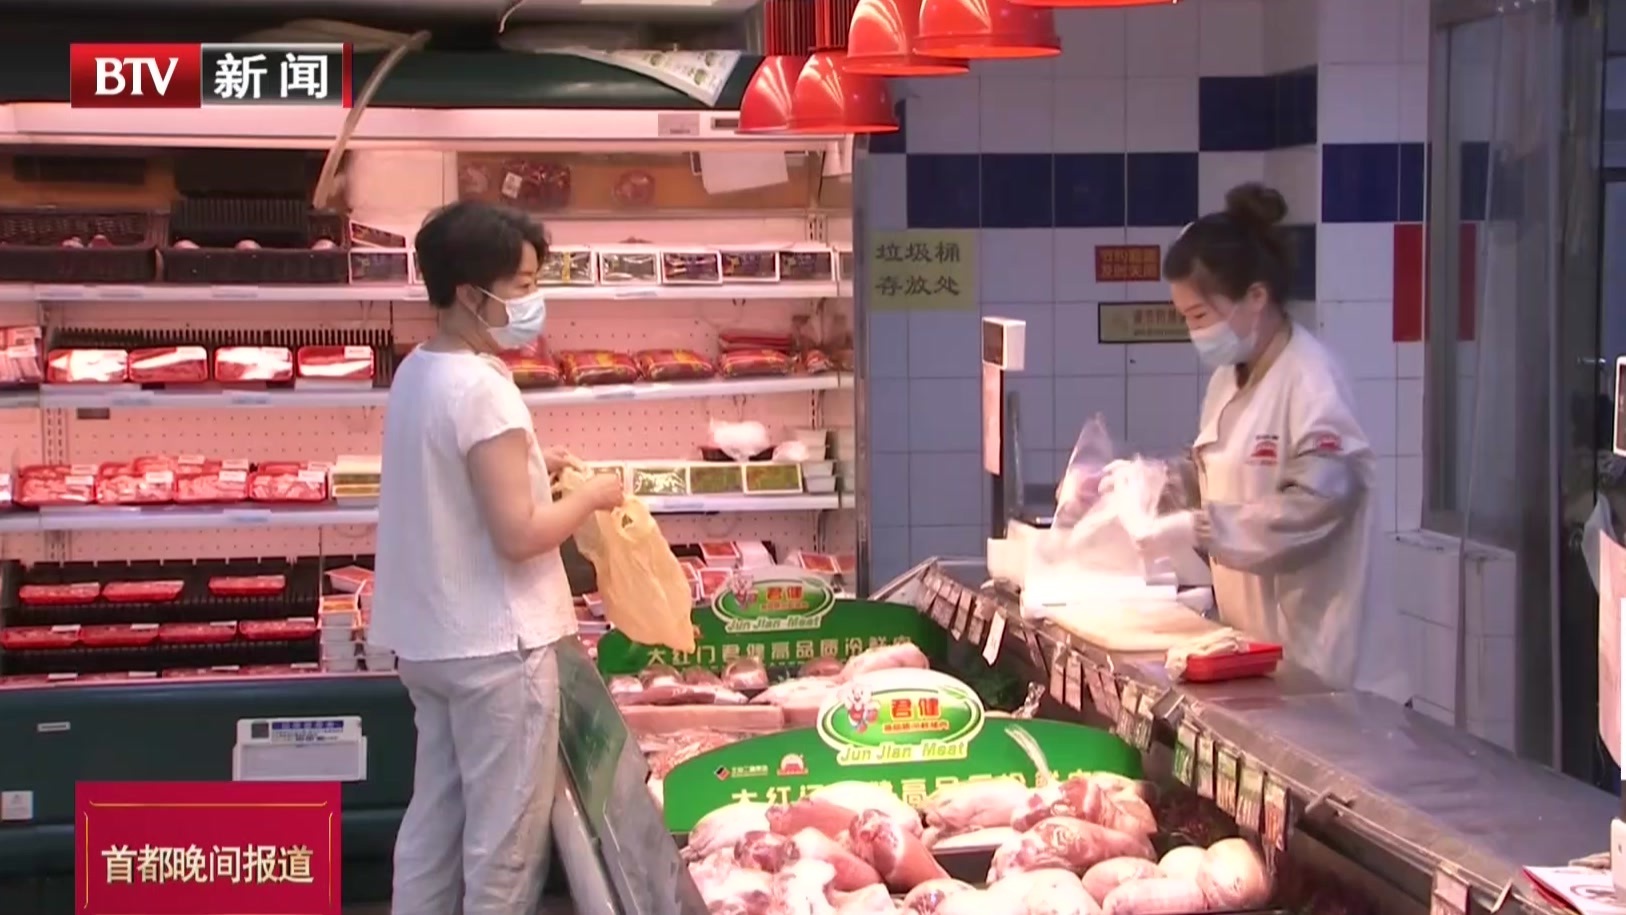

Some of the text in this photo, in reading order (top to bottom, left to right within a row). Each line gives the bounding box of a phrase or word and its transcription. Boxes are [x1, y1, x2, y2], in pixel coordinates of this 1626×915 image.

[875, 241, 961, 264] 垃圾桶
[874, 275, 961, 296] 存放处
[766, 585, 804, 600] 君健
[728, 618, 751, 631] Jun
[787, 615, 820, 627] Meat
[891, 698, 939, 718] 君健
[841, 747, 872, 762] Jun
[922, 742, 965, 757] Meat
